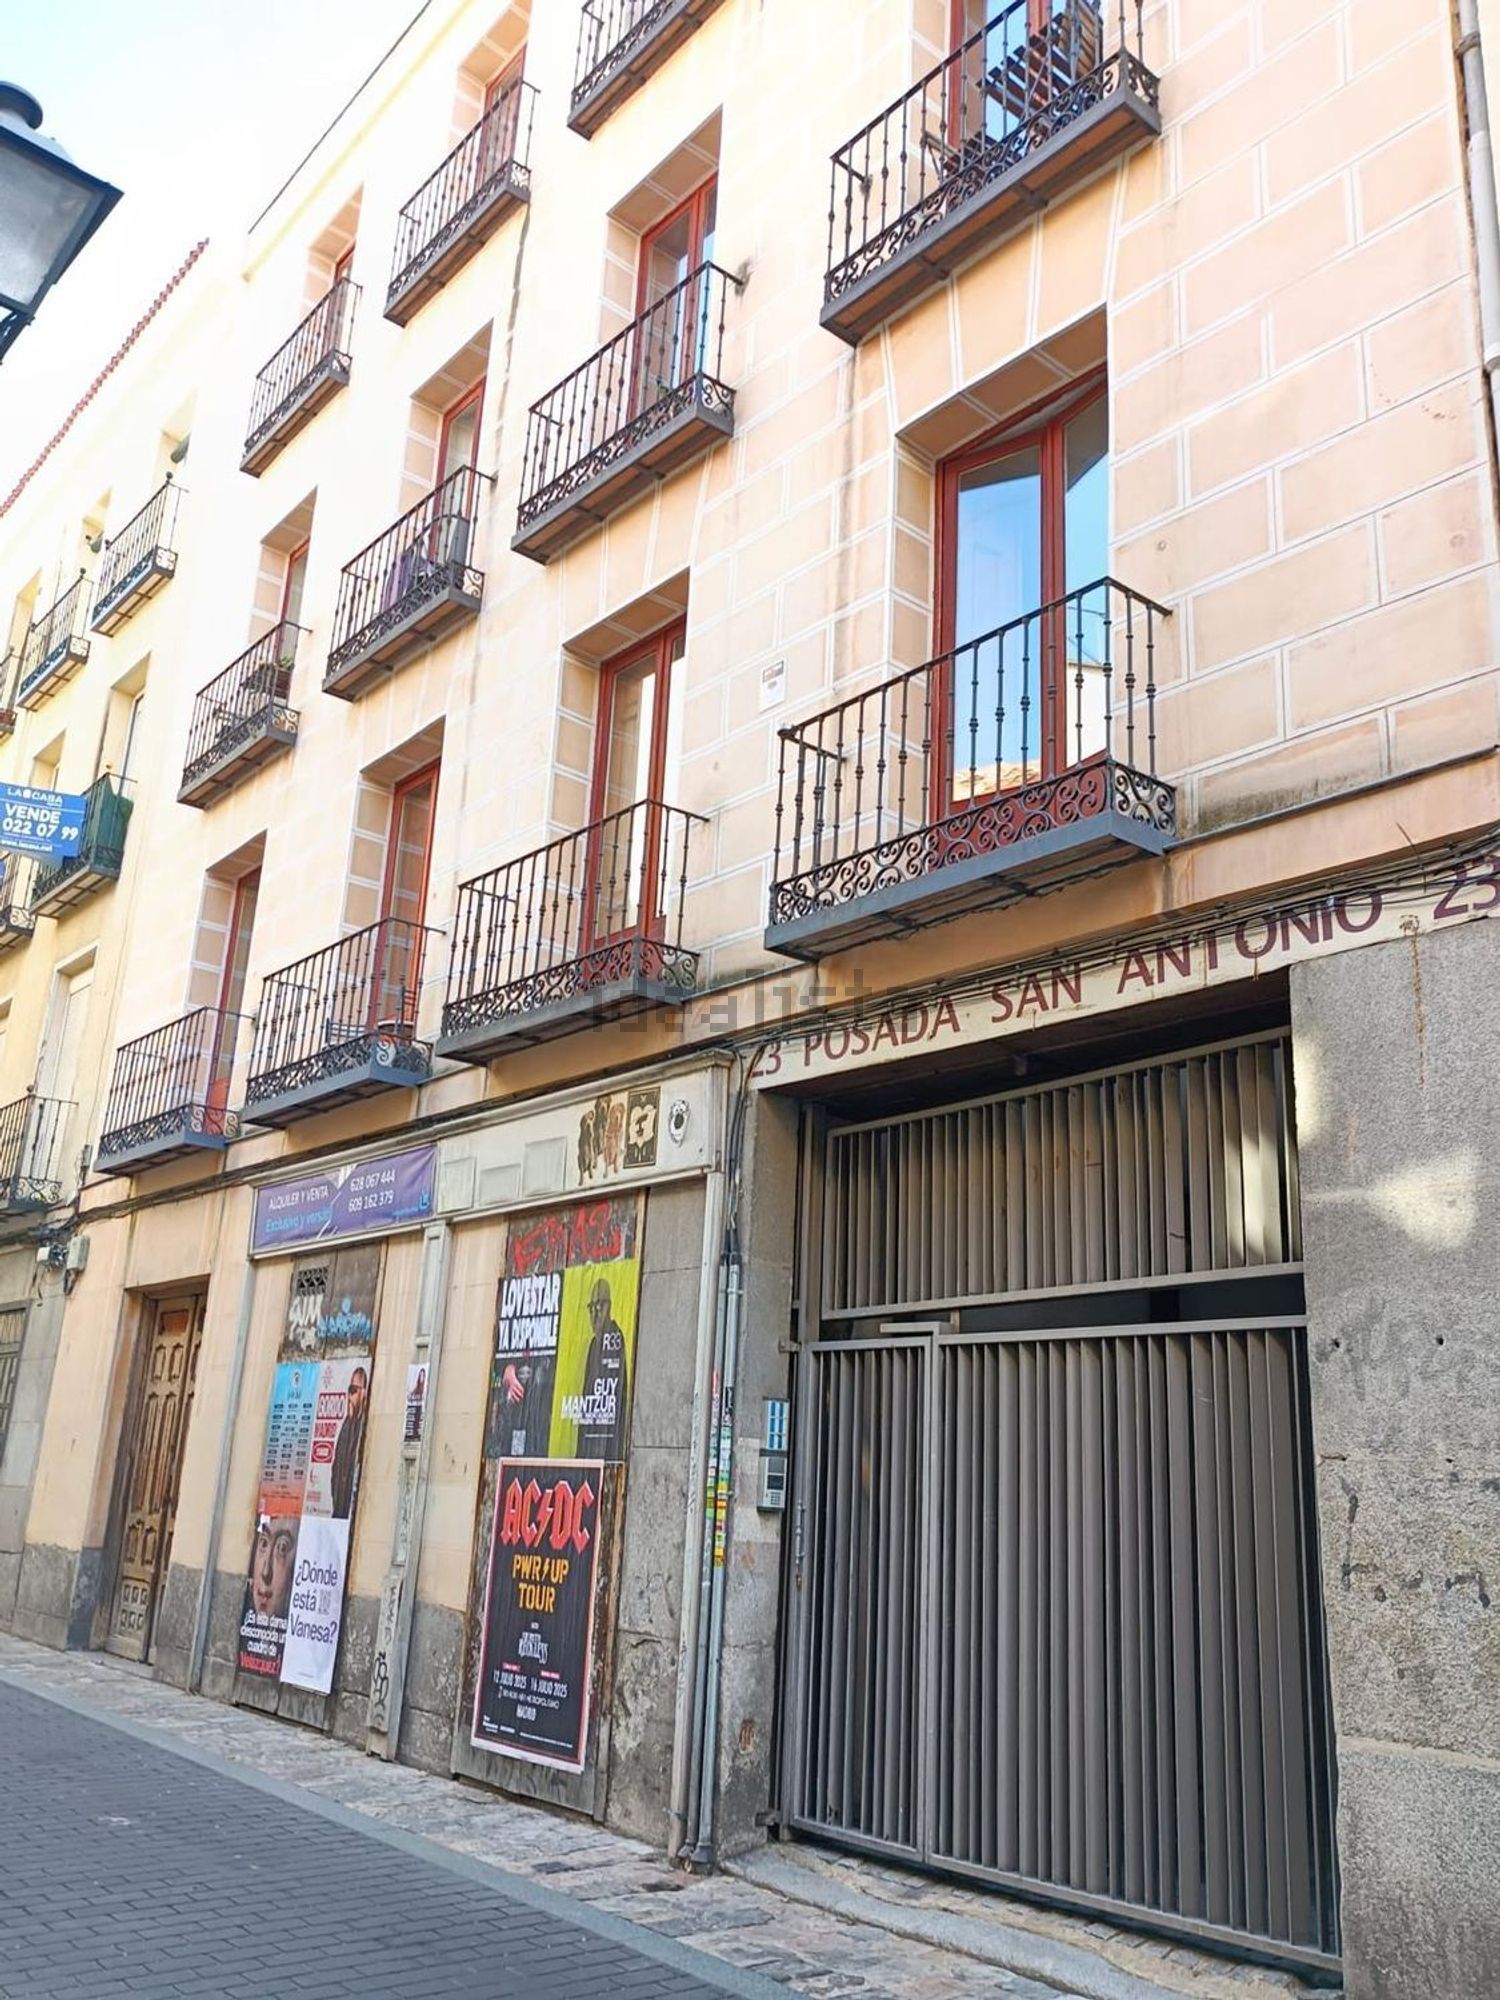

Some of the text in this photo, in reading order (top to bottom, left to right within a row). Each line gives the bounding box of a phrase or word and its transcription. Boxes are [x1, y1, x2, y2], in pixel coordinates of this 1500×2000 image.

[5, 803, 62, 824] VENDE
[2, 819, 79, 841] 022 07 99
[804, 995, 961, 1067] POSADA
[991, 961, 1082, 1024] SAN
[1117, 887, 1383, 994] ANTONIO
[381, 1169, 396, 1185] 444
[269, 1191, 300, 1210] ALQUILER
[306, 1185, 329, 1202] VENTA
[501, 1273, 561, 1318] LOVESTAR
[594, 1377, 618, 1396] GUY
[561, 1395, 617, 1416] MANTZUR
[295, 1560, 339, 1587] ¿Dónde
[293, 1588, 318, 1611] está
[518, 1582, 556, 1614] TOUR
[290, 1612, 338, 1645] Vanesa?
